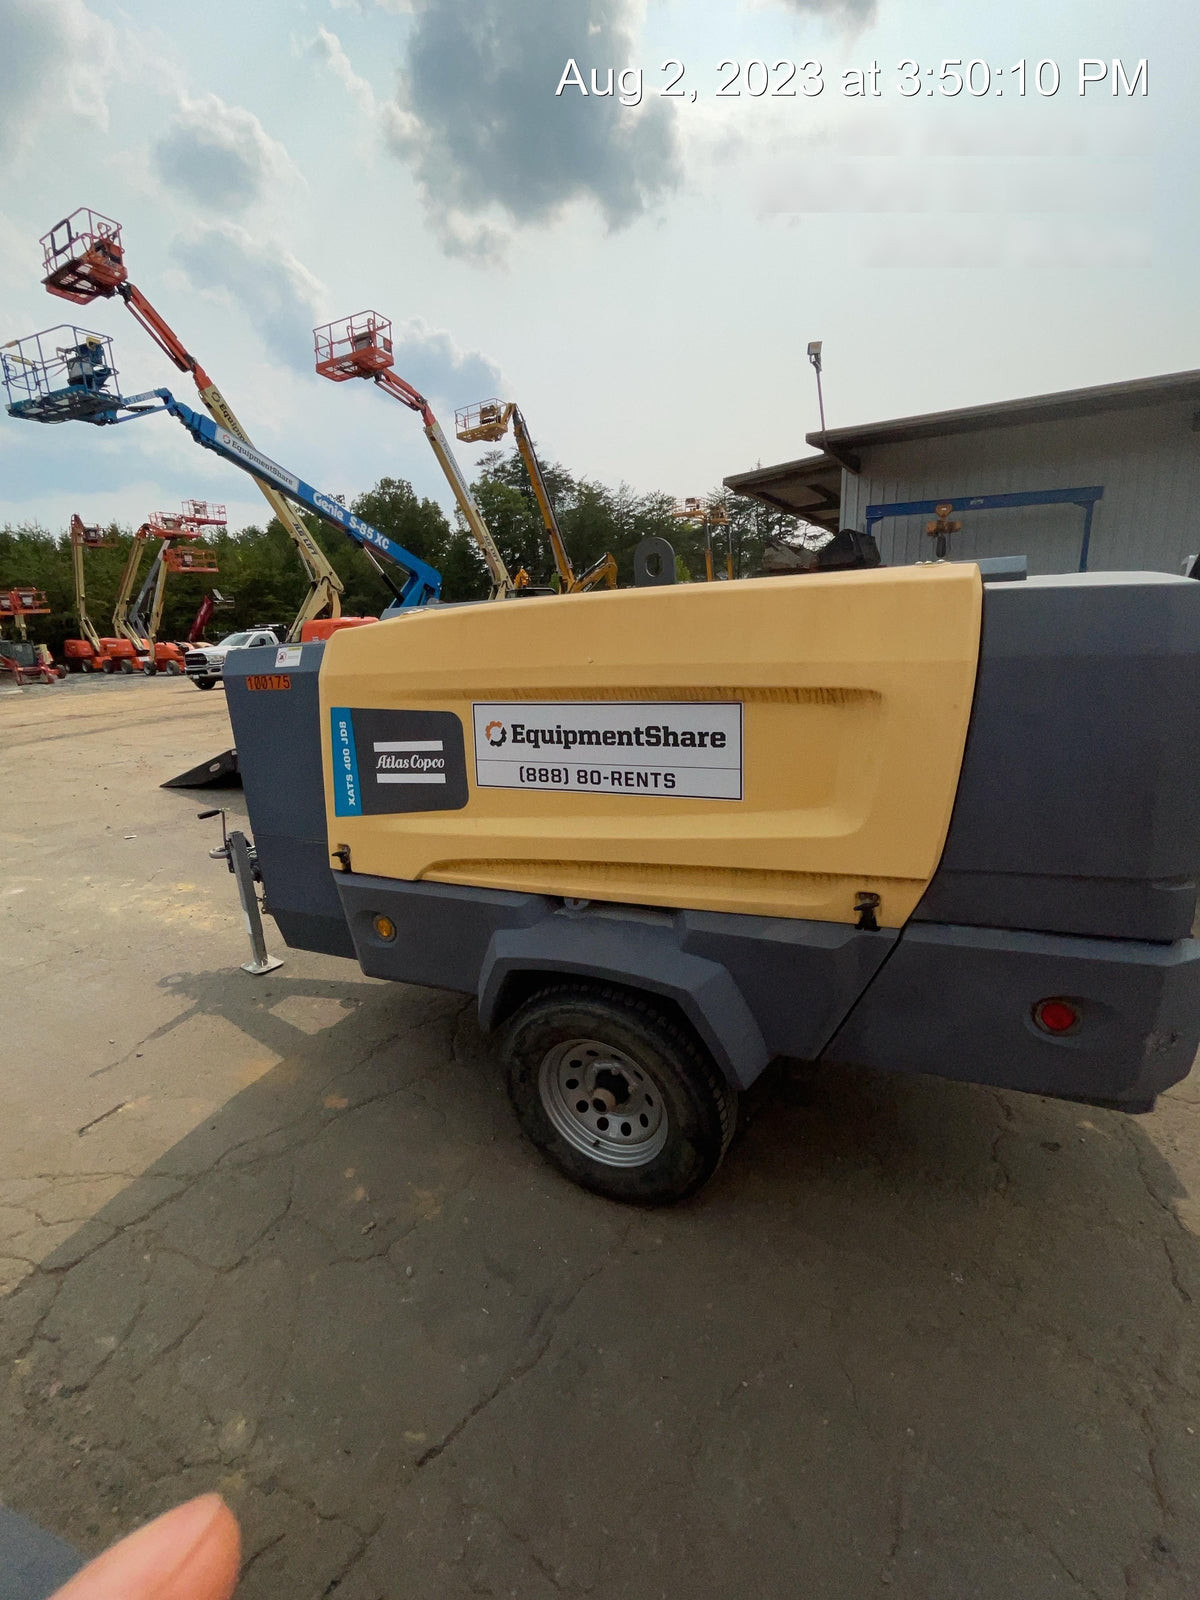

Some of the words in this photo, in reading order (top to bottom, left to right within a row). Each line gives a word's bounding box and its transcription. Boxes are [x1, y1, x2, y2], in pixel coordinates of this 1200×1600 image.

[231, 441, 294, 486] EquipmentShare
[312, 492, 345, 521] Genie
[348, 515, 375, 540] S-85
[374, 533, 391, 550] XC
[247, 675, 291, 690] 100175
[510, 723, 727, 750] EquipmentShare
[342, 748, 352, 770] 400
[375, 754, 409, 769] Atlas
[410, 754, 445, 771] Copco
[345, 773, 356, 806] XATS
[519, 766, 570, 785] (888)
[576, 769, 677, 790] 80-RENTS
